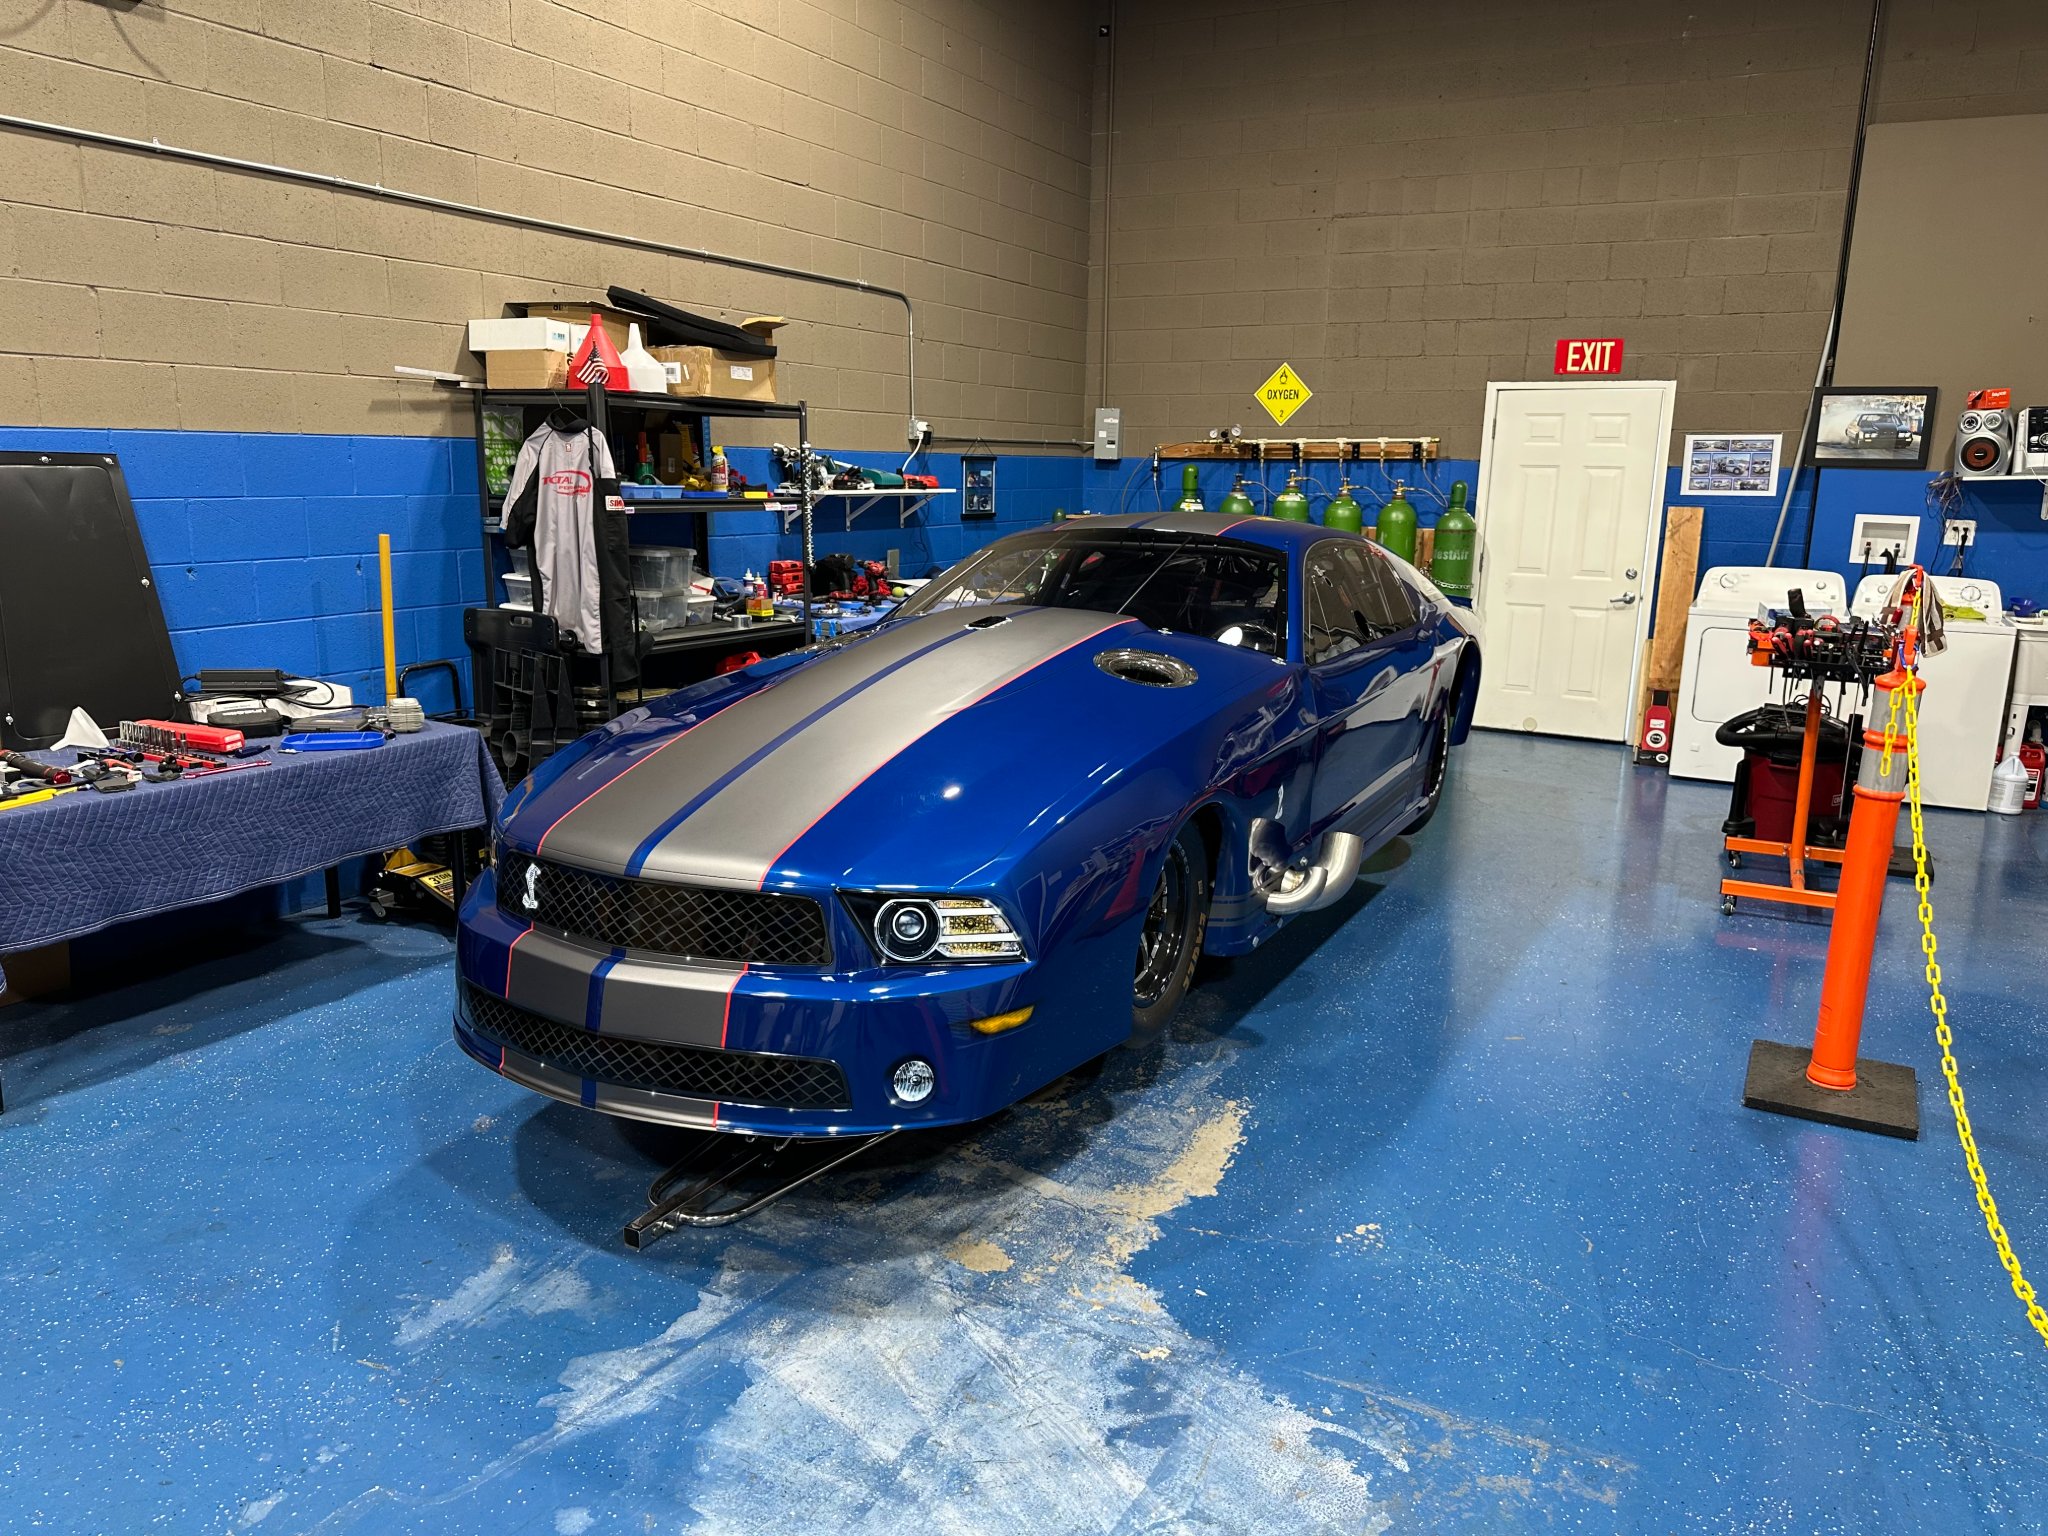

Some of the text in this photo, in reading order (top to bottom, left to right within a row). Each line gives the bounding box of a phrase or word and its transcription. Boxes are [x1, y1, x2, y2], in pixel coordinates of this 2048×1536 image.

[1566, 341, 1616, 371] EXIT
[1267, 389, 1299, 400] OXYGEN
[1279, 409, 1284, 417] 2
[1434, 549, 1469, 560] estAir
